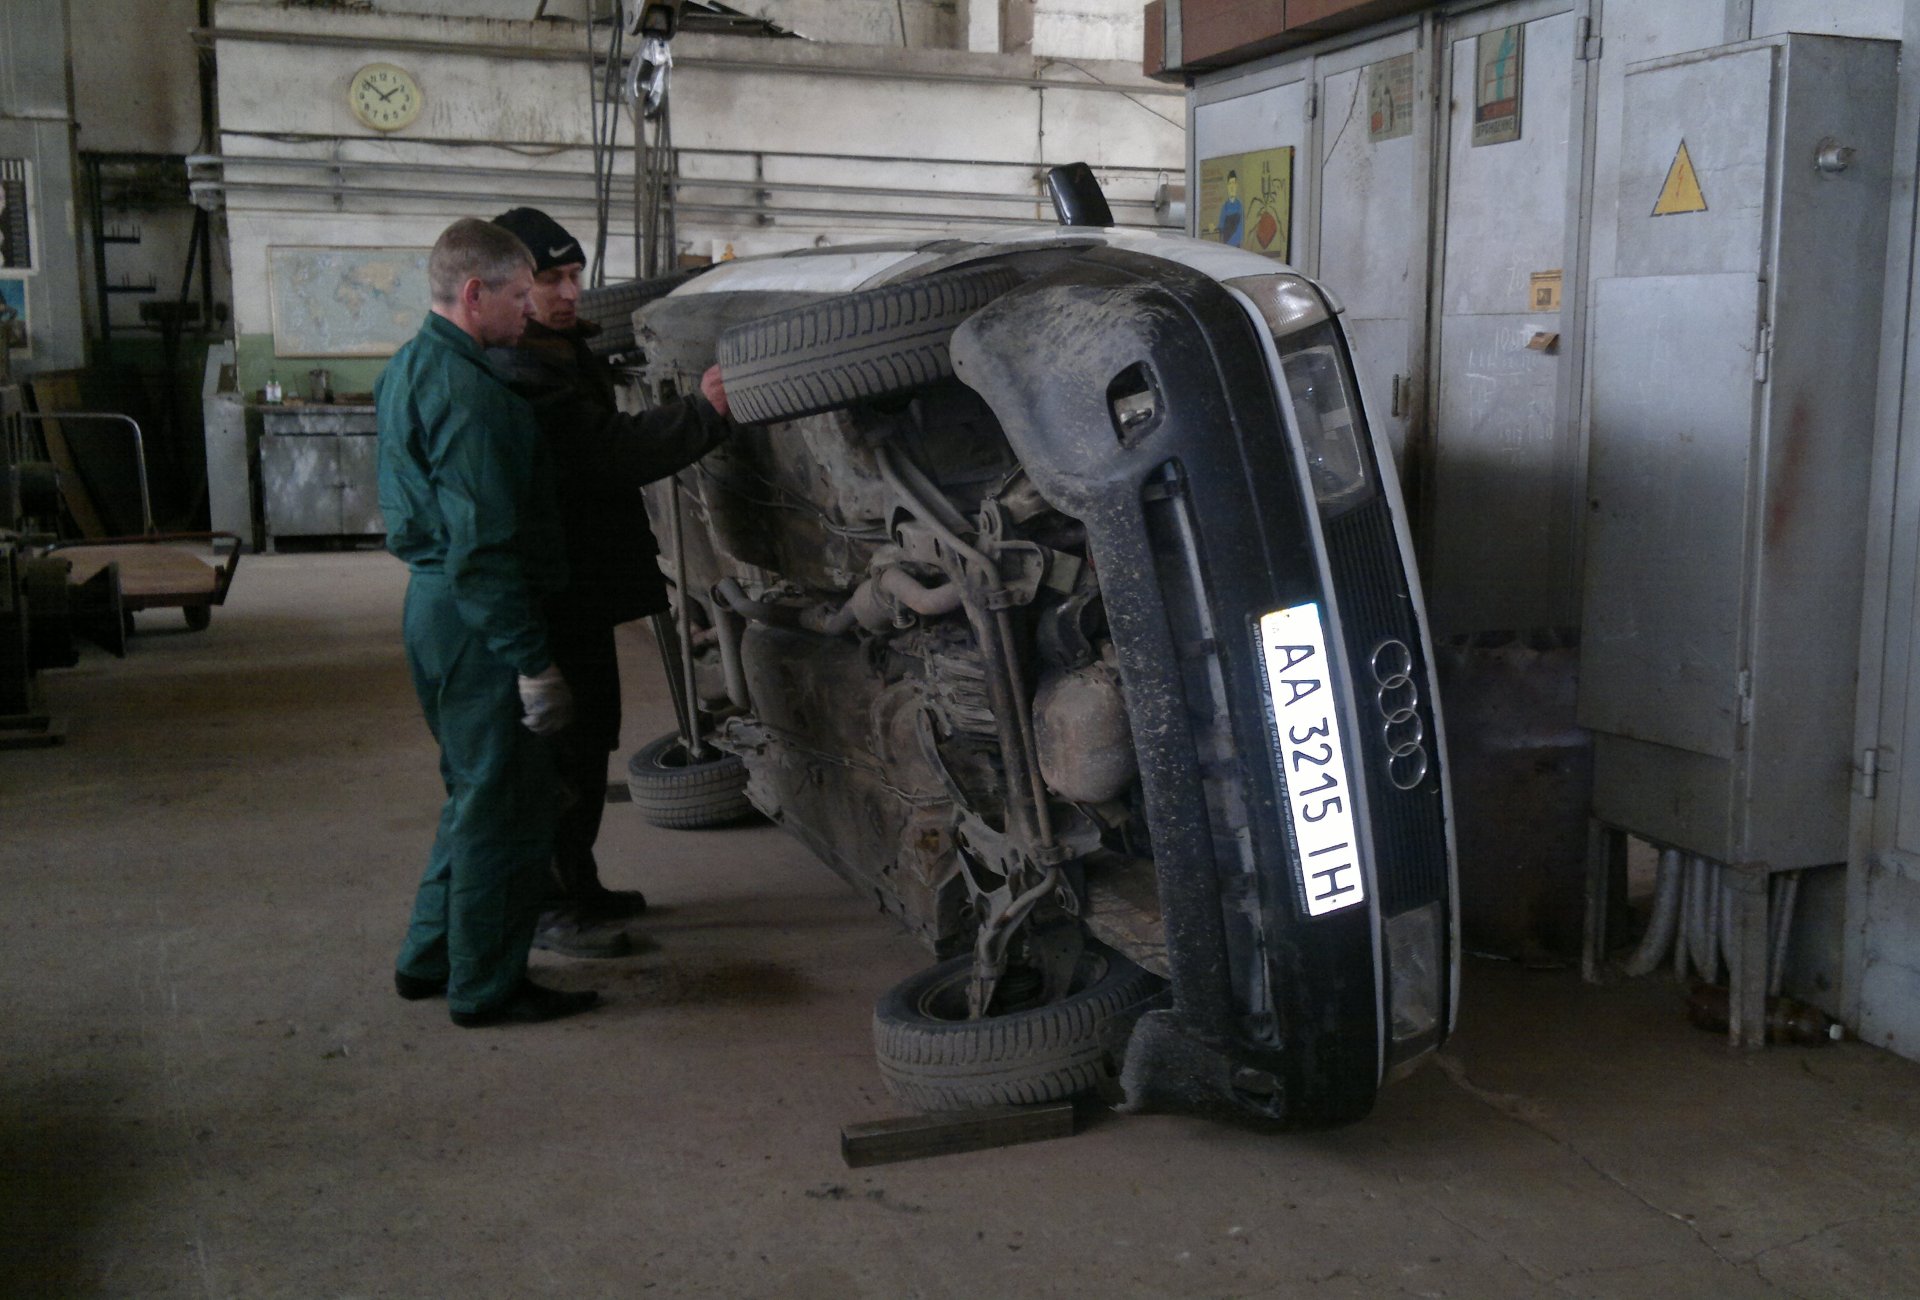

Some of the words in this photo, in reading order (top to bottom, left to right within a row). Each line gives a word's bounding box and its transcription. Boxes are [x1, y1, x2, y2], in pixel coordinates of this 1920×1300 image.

[1252, 623, 1270, 691] АВТОМАГАЗИН
[1275, 645, 1322, 707] AA
[1289, 717, 1343, 823] 3215
[1309, 842, 1354, 900] IH
